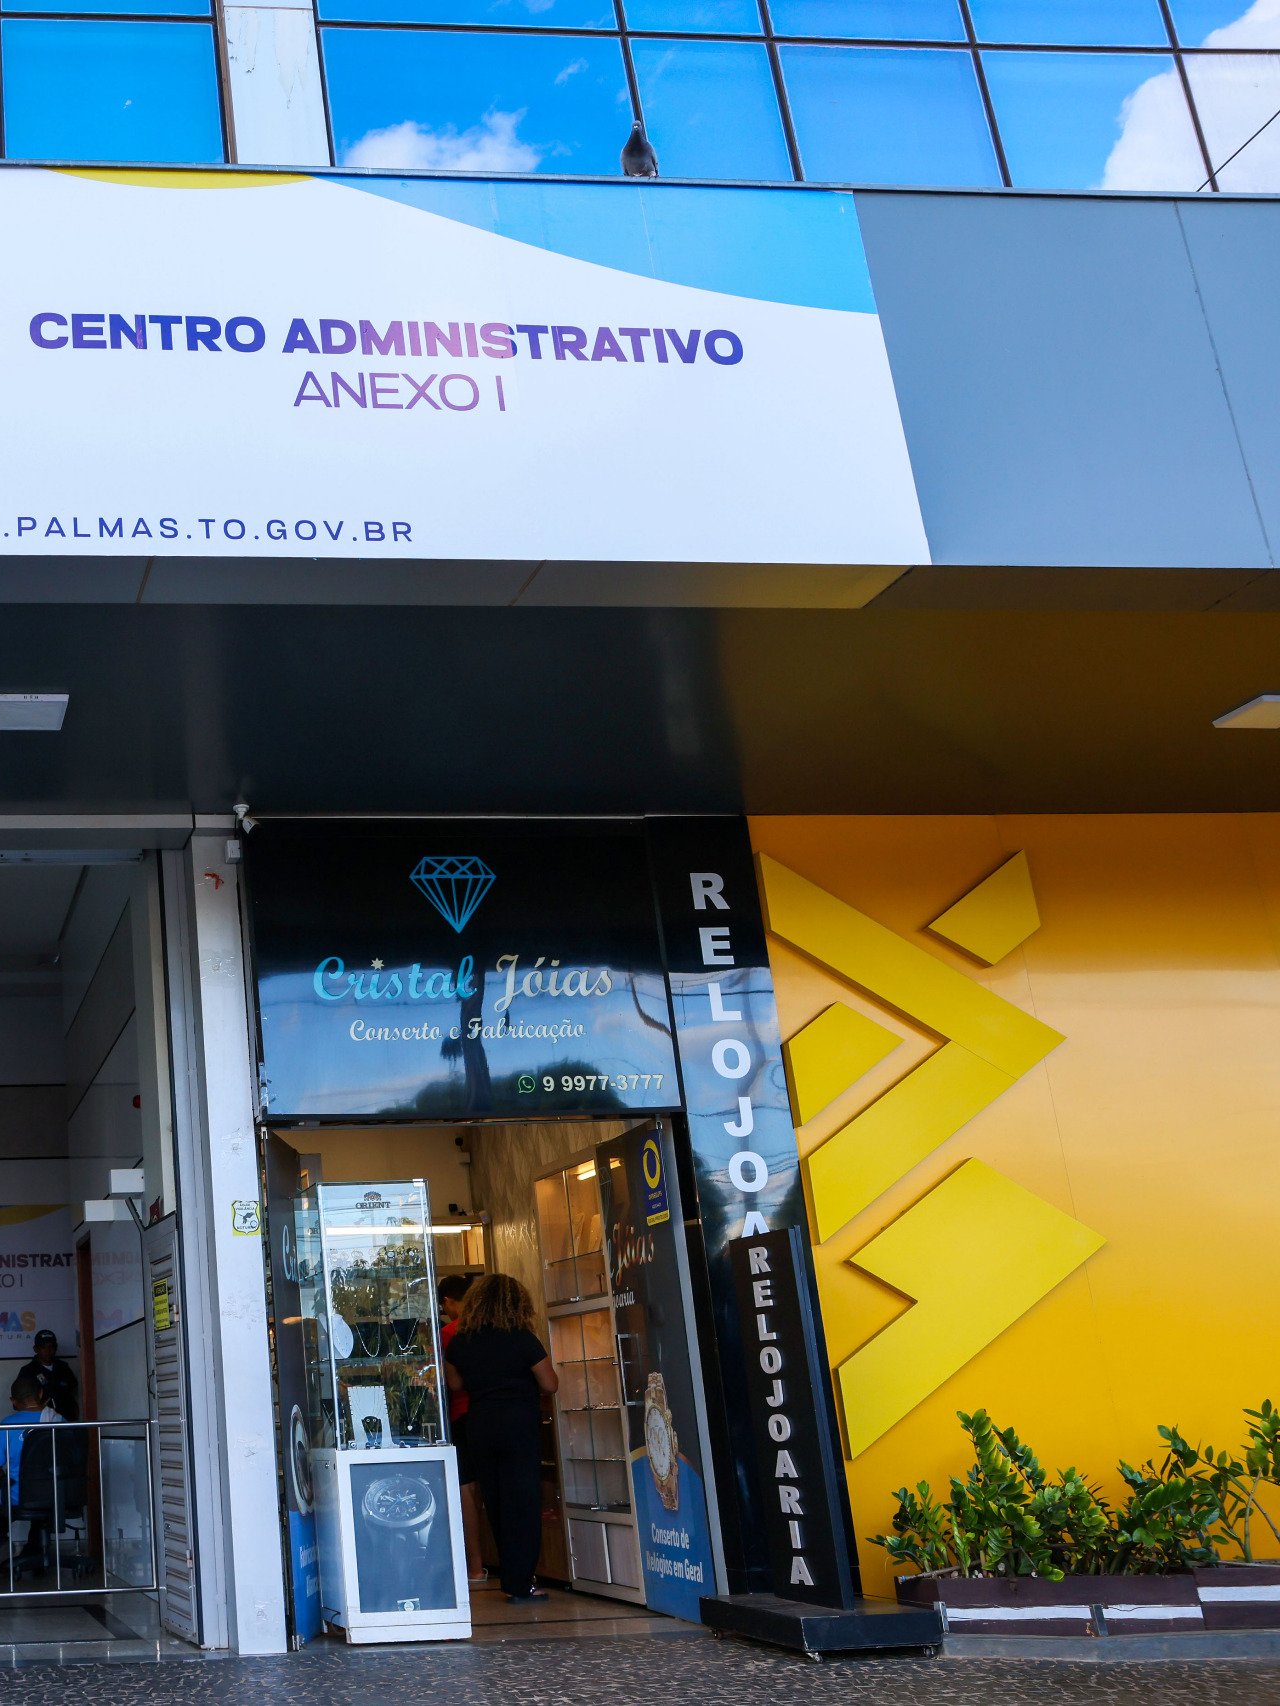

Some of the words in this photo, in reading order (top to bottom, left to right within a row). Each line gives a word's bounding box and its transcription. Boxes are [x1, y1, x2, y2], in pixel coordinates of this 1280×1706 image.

[29, 312, 266, 353] CENTRO
[281, 318, 745, 366] ADMINISTRATIVO
[293, 370, 480, 411] ANEXO
[496, 375, 506, 412] I
[313, 954, 477, 1000] Cristal
[494, 953, 614, 1012] Jóias
[350, 1018, 442, 1042] Conserto
[446, 1027, 461, 1042] e
[466, 1017, 586, 1045] Fabricação
[542, 1076, 555, 1092] 9
[561, 1074, 664, 1092] 9977-3777
[355, 1201, 391, 1210] ORIENT
[749, 1246, 815, 1586] RELOJOARIA
[652, 1523, 680, 1548] Conserto
[681, 1528, 690, 1550] de
[646, 1551, 673, 1578] Relógios
[673, 1560, 685, 1579] em
[684, 1558, 704, 1584] Geral
